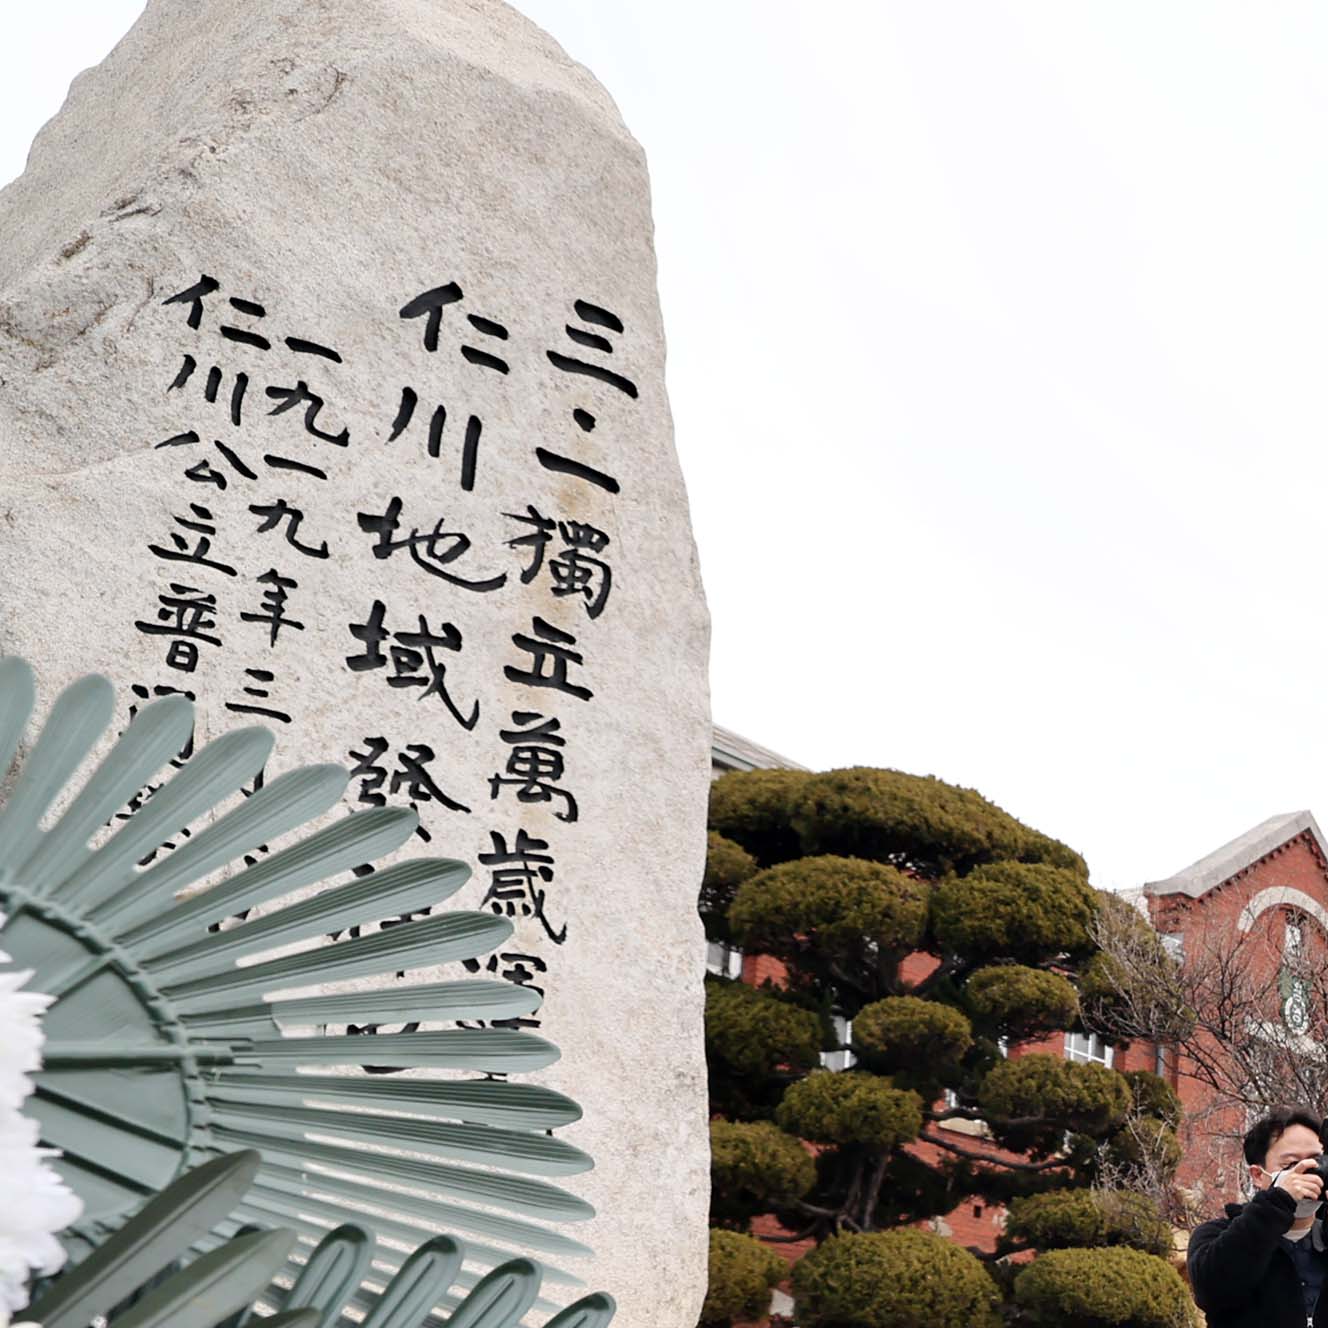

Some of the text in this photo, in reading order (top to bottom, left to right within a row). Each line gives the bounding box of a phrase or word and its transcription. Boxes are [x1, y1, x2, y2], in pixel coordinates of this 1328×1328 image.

[225, 337, 349, 798] 一九一九年三
[327, 282, 510, 940] 仁川地域發
